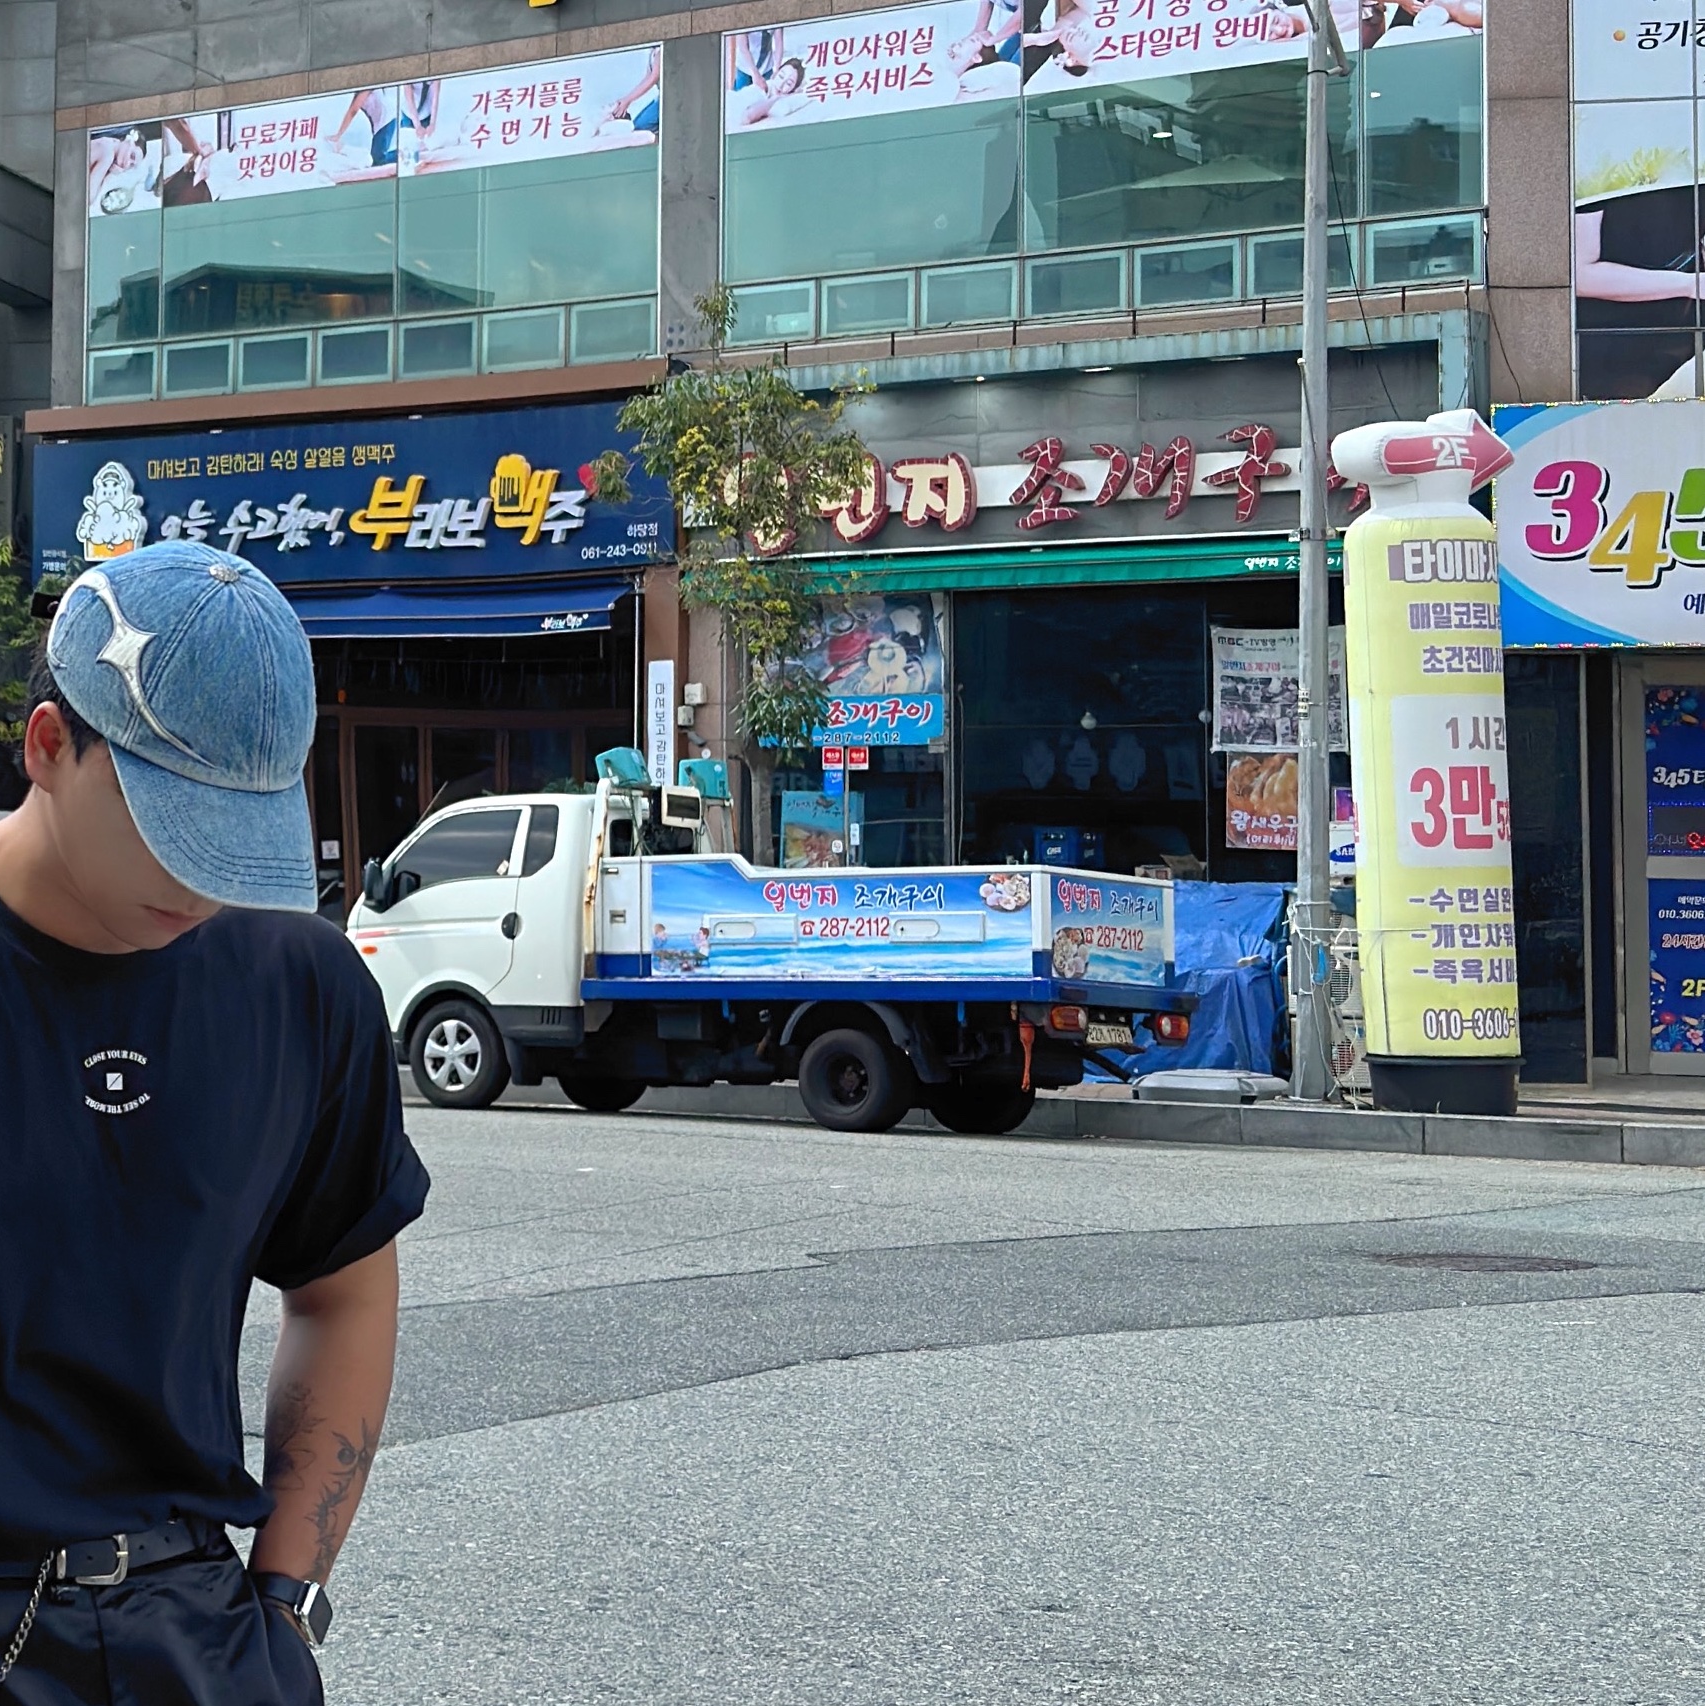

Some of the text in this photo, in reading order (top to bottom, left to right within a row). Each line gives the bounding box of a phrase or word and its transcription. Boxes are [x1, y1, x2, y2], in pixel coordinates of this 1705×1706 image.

[805, 26, 934, 67] 개인샤워실
[1093, 13, 1269, 60] 스타일러 완비
[470, 78, 582, 116] 가족커플룸
[805, 63, 934, 103] 족욕서비스
[238, 116, 318, 145] 무료카페
[238, 147, 318, 180] 맛집이용
[147, 443, 396, 480] 마셔보고 감탄하라! 숙성 살얼음 생맥주
[1432, 437, 1470, 467] 2F
[655, 682, 665, 736] 마셔보고
[826, 698, 933, 728] 조개구이
[763, 881, 944, 913] 일번지 조개구이
[1057, 879, 1160, 922] 일번지 조개구이
[819, 917, 890, 938] 287-2112
[1097, 925, 1144, 952] 287-2112
[84, 1049, 147, 1068] CLOSE YOUR EYES
[122, 1099, 139, 1113] SEE
[138, 1093, 151, 1105] TO
